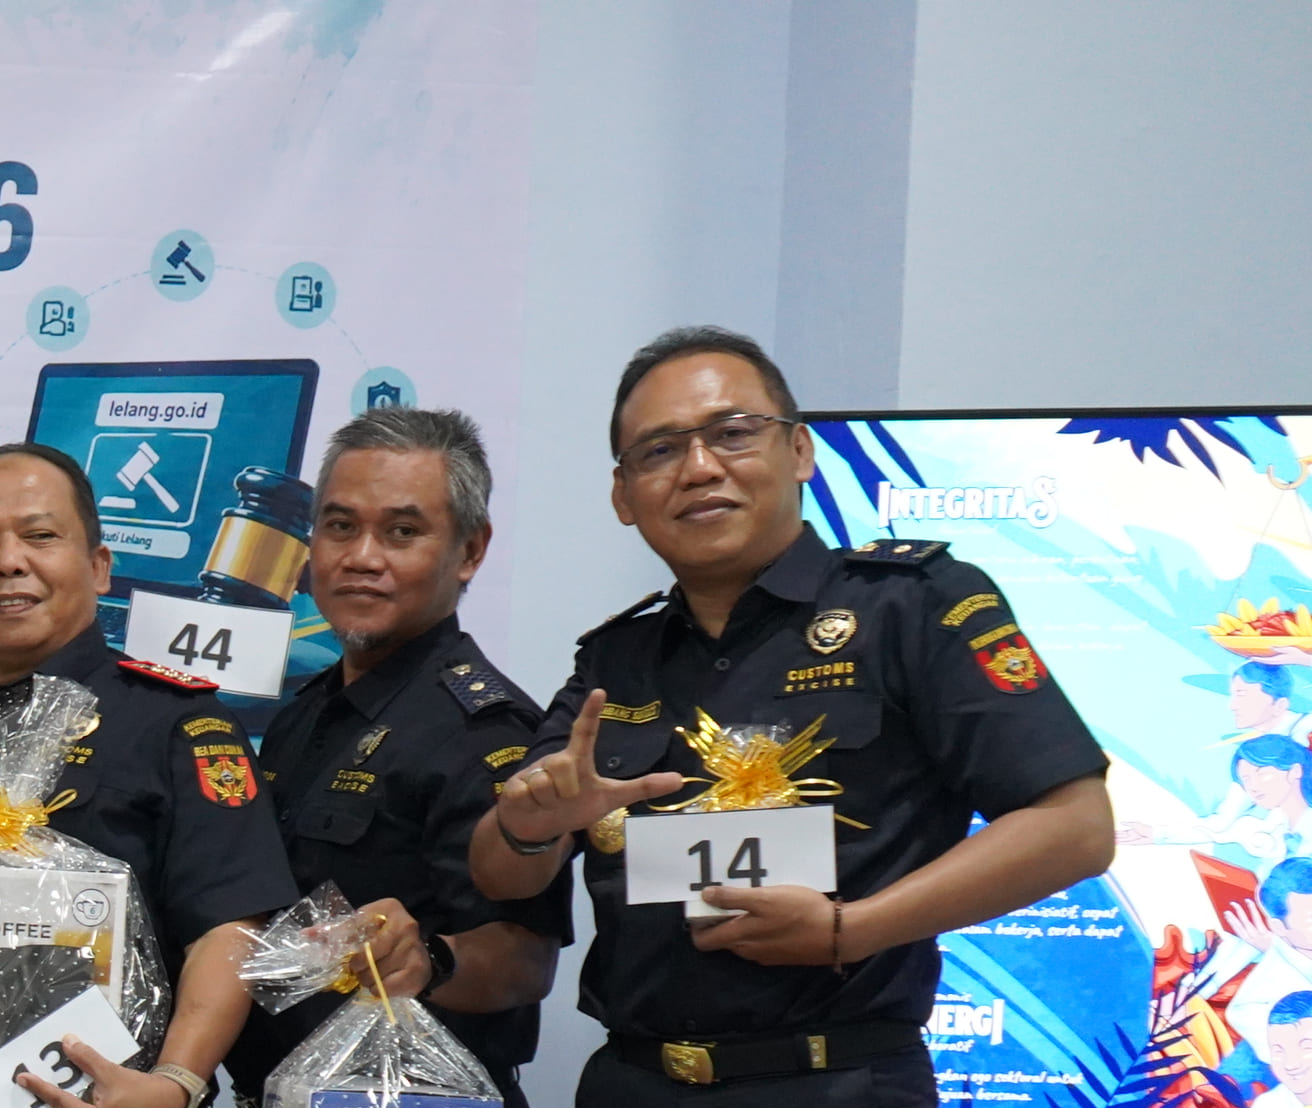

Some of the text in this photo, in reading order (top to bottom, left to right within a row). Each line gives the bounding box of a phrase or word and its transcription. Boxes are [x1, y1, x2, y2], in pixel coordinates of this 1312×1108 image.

[109, 400, 208, 422] lelang.go.id
[101, 531, 152, 550] kuti Lelang
[167, 623, 233, 671] 44
[787, 662, 855, 681] CUSTOMS
[687, 836, 768, 892] 14
